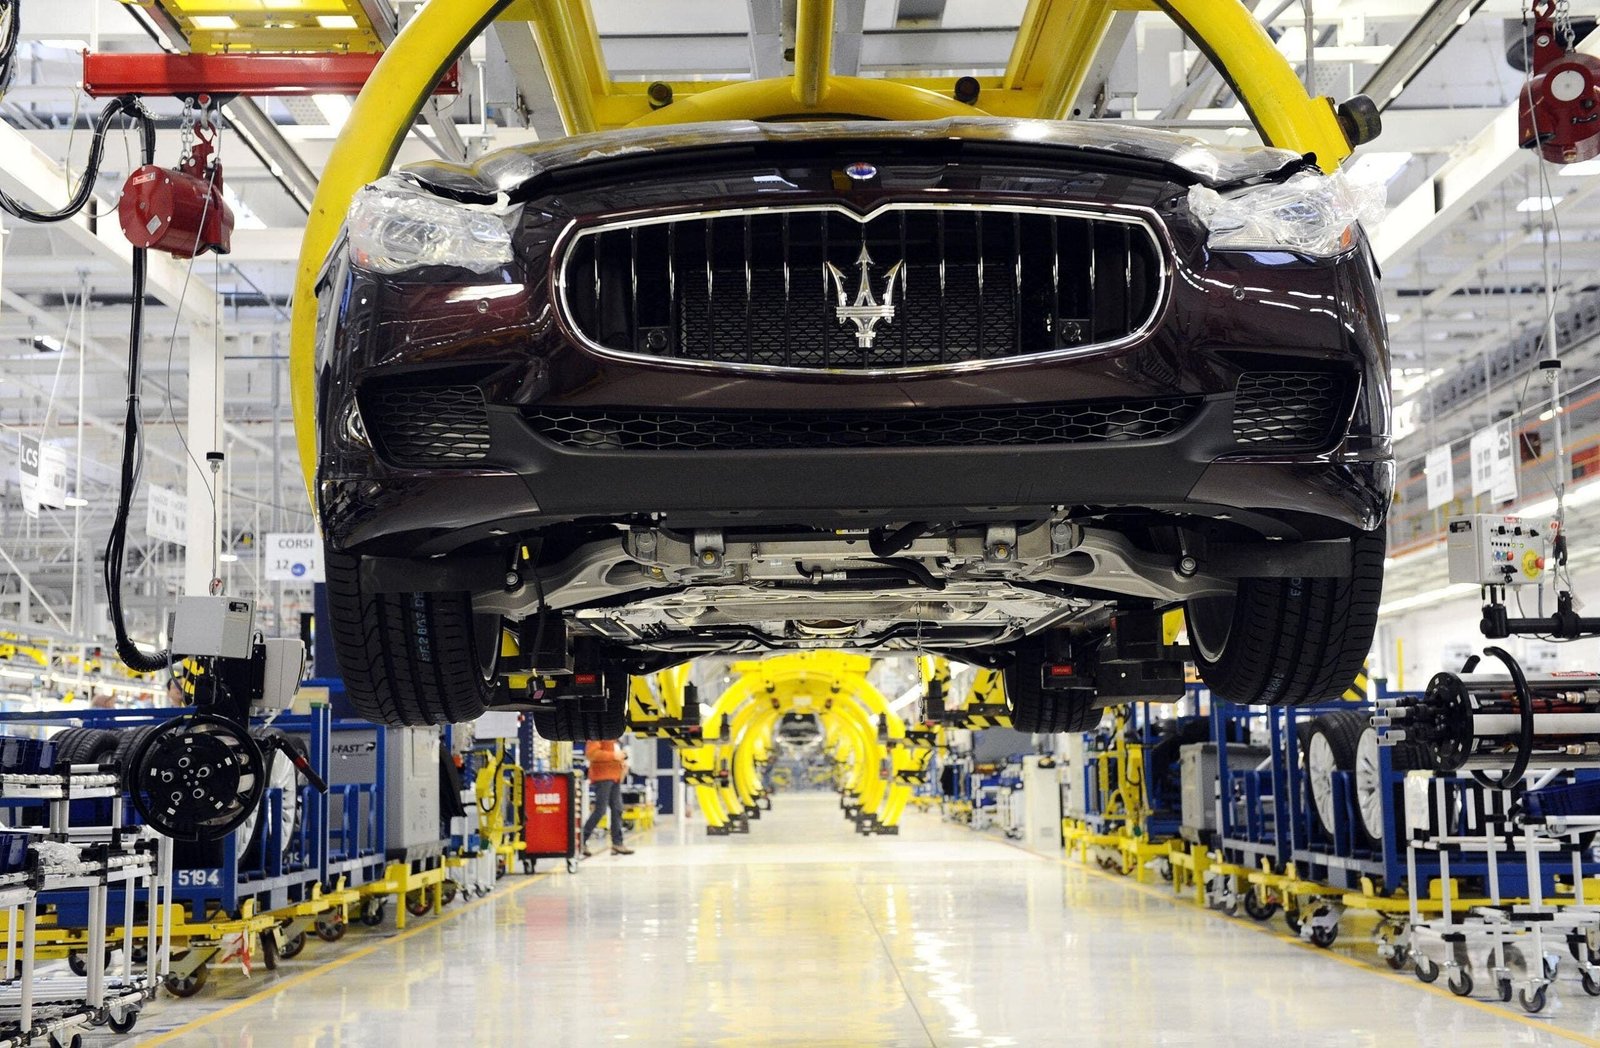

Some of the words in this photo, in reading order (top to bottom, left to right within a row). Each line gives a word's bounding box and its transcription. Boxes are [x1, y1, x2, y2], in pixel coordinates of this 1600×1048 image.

[21, 445, 38, 468] LCS
[279, 538, 313, 549] CORSI
[277, 560, 289, 570] 12
[178, 869, 220, 886] 5194
